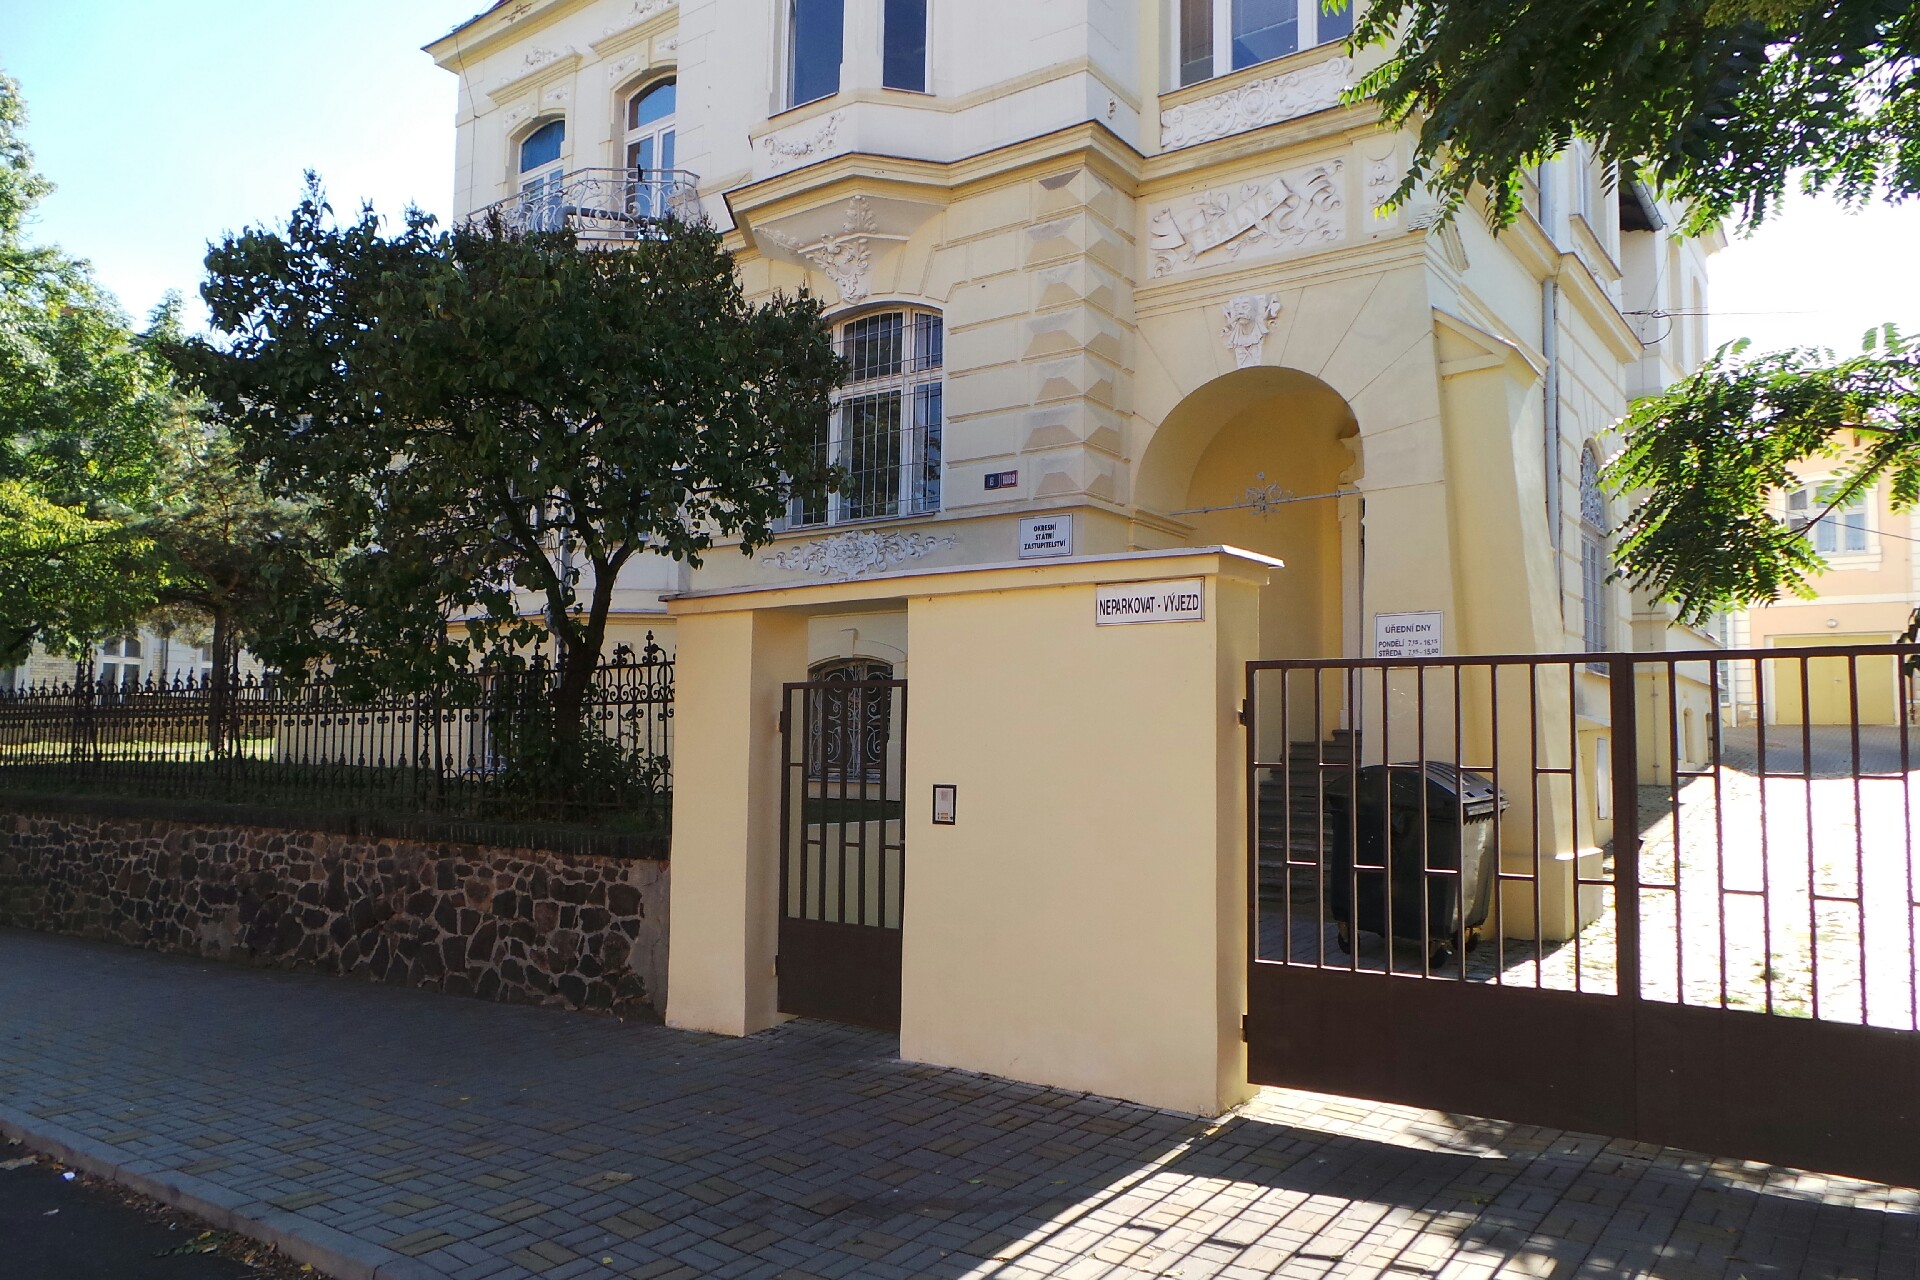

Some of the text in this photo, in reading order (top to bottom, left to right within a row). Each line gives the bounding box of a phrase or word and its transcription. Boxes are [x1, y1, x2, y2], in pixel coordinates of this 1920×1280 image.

[1033, 522, 1057, 532] OKRESNÍ
[1035, 531, 1055, 541] STÁTNÍ
[1024, 539, 1066, 550] ZASTUPITELSTVÍ
[1099, 596, 1155, 615] NEPARKOVAT
[1163, 592, 1199, 612] VÝJEZD
[1385, 623, 1432, 634] ÚŘEDNÍ DNY
[1378, 639, 1405, 648] PONDĚLÍ
[1378, 649, 1402, 657] STŘEDA
